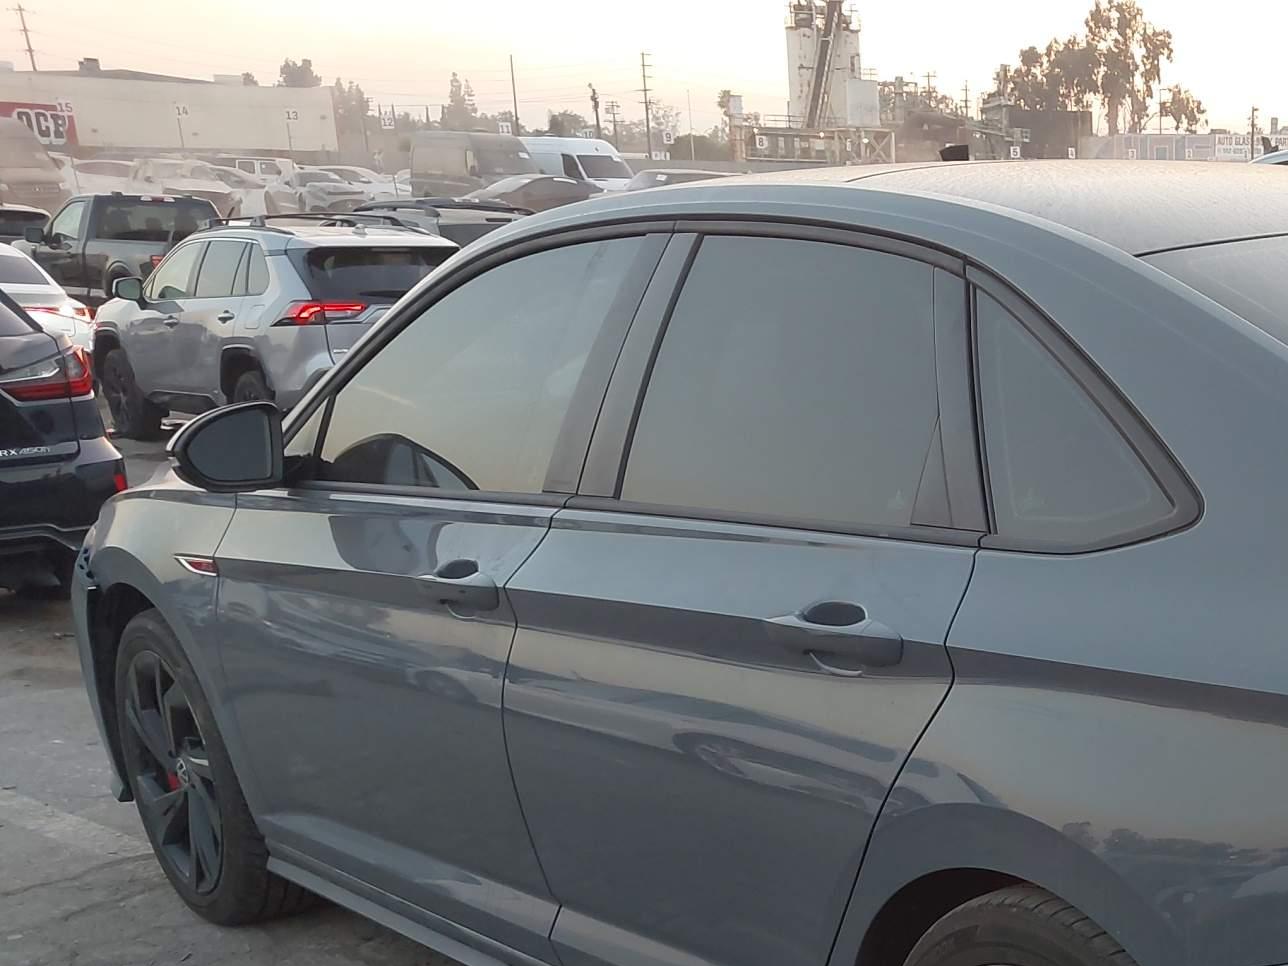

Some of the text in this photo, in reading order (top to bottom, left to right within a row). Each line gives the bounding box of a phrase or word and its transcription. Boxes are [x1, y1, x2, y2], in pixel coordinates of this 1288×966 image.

[57, 102, 73, 112] 15
[176, 106, 189, 116] 14
[286, 110, 298, 120] 13
[382, 117, 394, 127] 12
[500, 124, 510, 134] 11
[665, 132, 672, 141] 9
[1217, 136, 1233, 146] AUTO
[758, 137, 765, 147] 8
[1012, 147, 1018, 157] 5
[0, 448, 18, 457] RX
